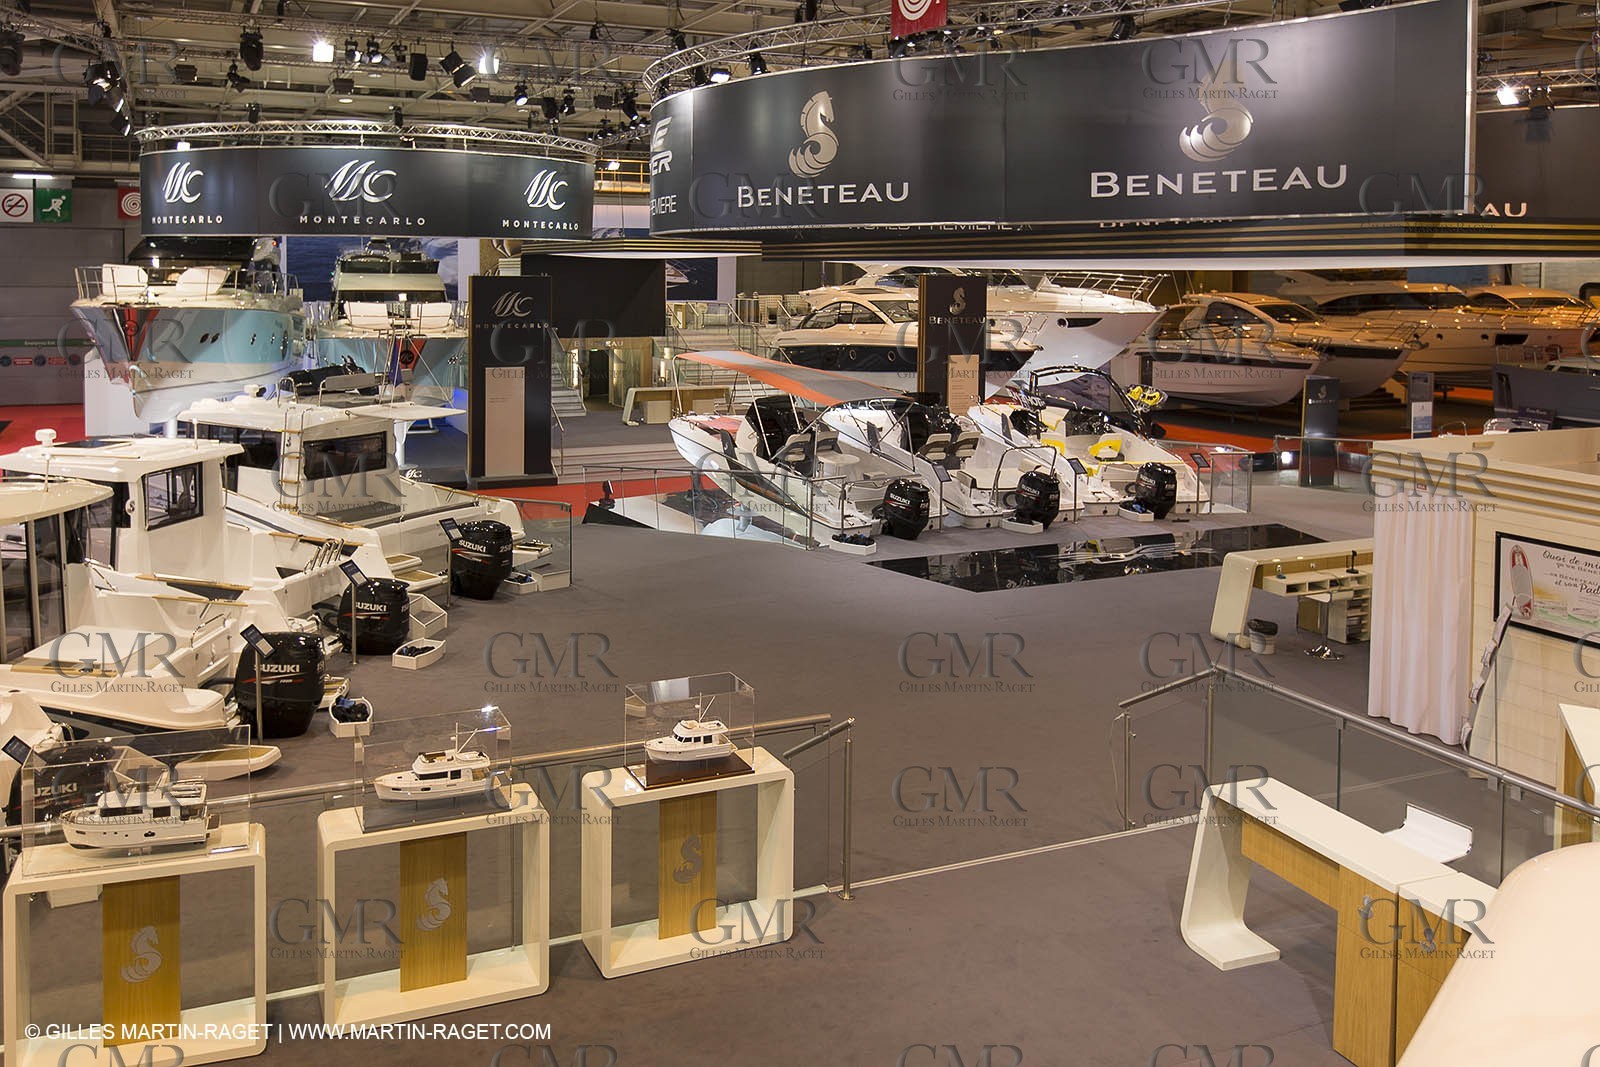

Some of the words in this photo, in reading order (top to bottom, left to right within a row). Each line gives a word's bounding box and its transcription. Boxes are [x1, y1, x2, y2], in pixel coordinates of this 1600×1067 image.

[1089, 164, 1348, 199] BENETEAU
[737, 181, 910, 209] BENETEAU
[151, 215, 224, 224] MONTECARLO
[299, 215, 427, 226] MONTECARLO
[502, 219, 580, 231] MONTECARLO
[474, 322, 549, 330] MONTECARLO
[928, 314, 986, 326] BENETEAU
[889, 492, 911, 505] SUZUKI
[458, 539, 487, 553] SUZUKI
[1542, 550, 1566, 563] Quoi
[1569, 556, 1580, 565] de
[33, 782, 78, 798] UZUKI
